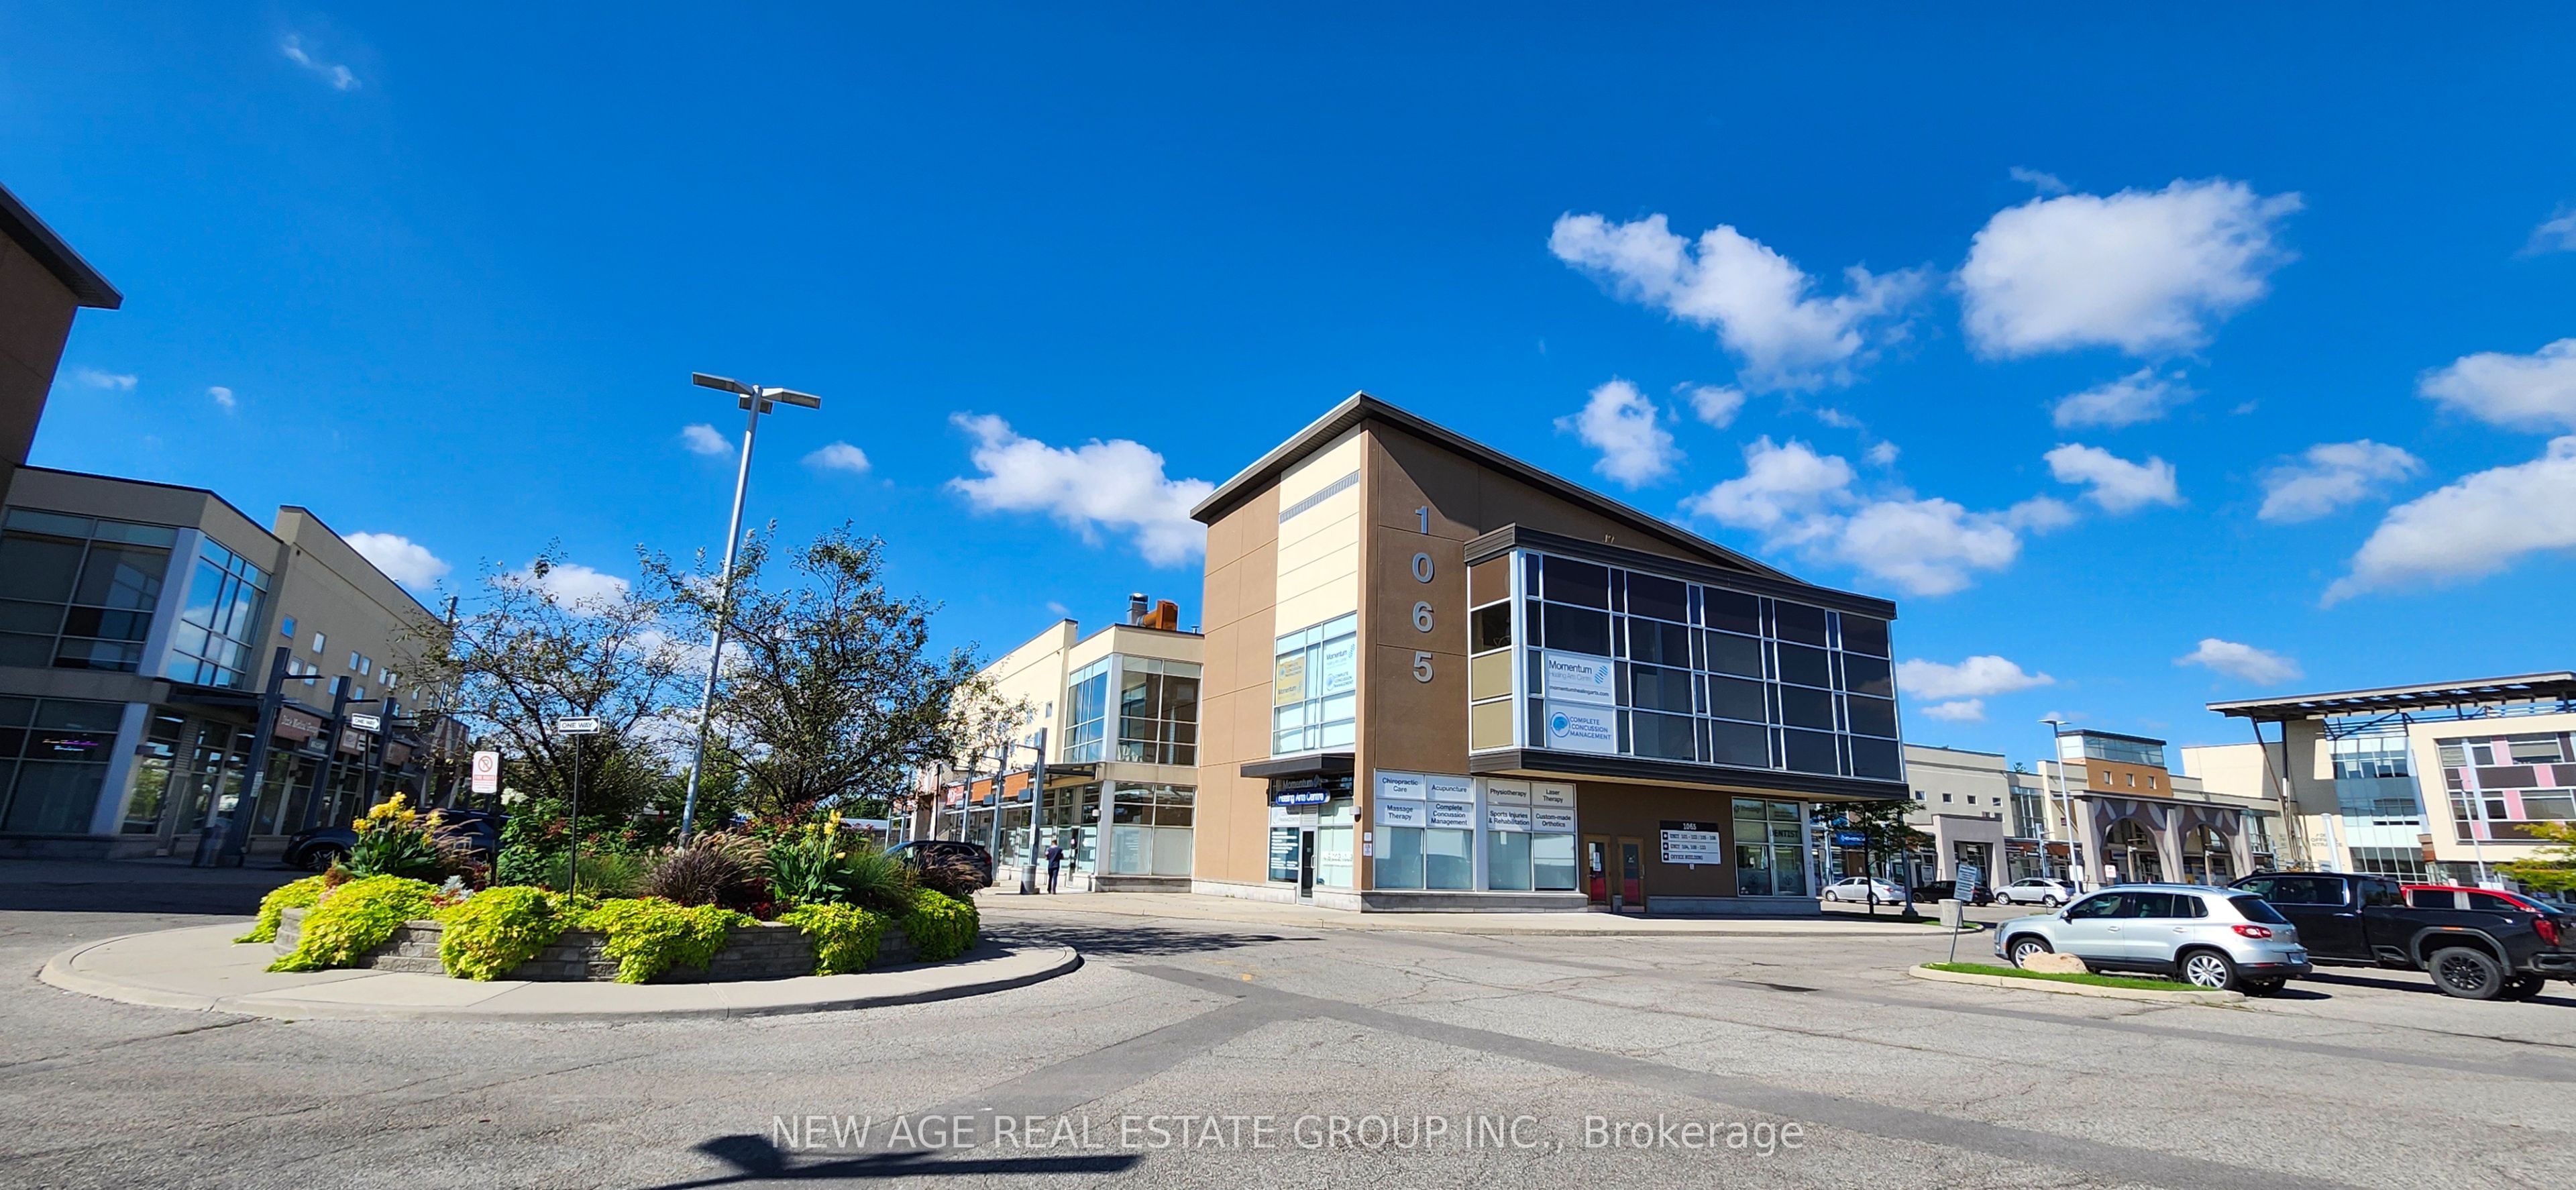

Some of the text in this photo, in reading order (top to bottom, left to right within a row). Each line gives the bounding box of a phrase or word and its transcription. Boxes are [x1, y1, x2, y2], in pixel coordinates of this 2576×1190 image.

[1412, 505, 1434, 684] 1065
[1549, 659, 1593, 674] Momentum
[1570, 716, 1600, 725] COMPLETE
[1572, 724, 1608, 733] CONCUSSION
[1570, 731, 1611, 740] MANAGEMENT
[1283, 779, 1313, 790] Momentum
[1382, 777, 1418, 786] Chiropractic
[1432, 784, 1467, 793] Acupuncture
[1490, 788, 1527, 798] Physiotherapy
[1387, 805, 1413, 813] Massage
[1388, 812, 1412, 820] Therapy
[1509, 811, 1527, 819] Injuries
[1431, 818, 1468, 826] Management
